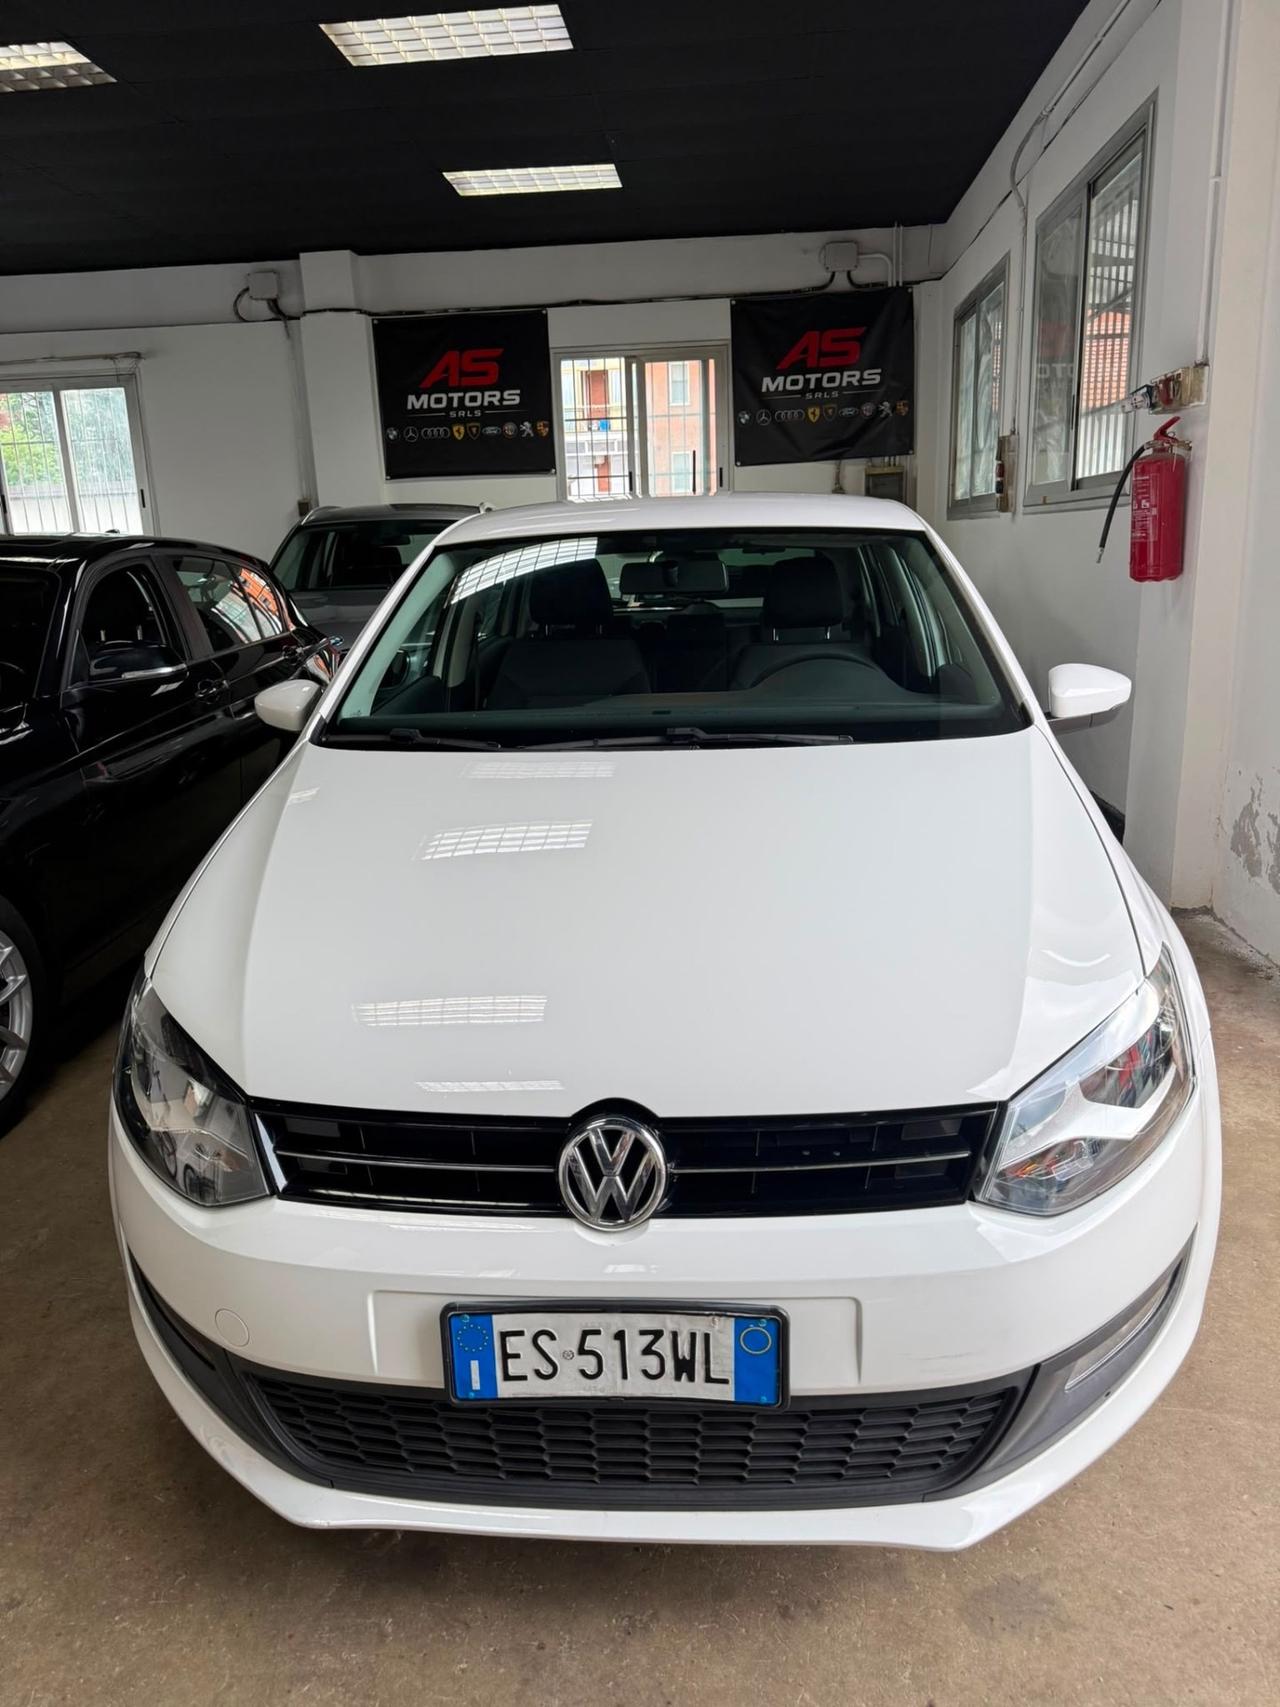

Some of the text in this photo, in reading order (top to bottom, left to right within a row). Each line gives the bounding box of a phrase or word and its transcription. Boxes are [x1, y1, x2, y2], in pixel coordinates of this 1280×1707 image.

[776, 326, 867, 371] AS
[419, 348, 504, 389] AS
[761, 368, 882, 393] MOTORS
[406, 389, 521, 410] MOTORS
[805, 390, 839, 400] SRLS
[449, 409, 482, 418] SRLS
[500, 1329, 558, 1382] ES
